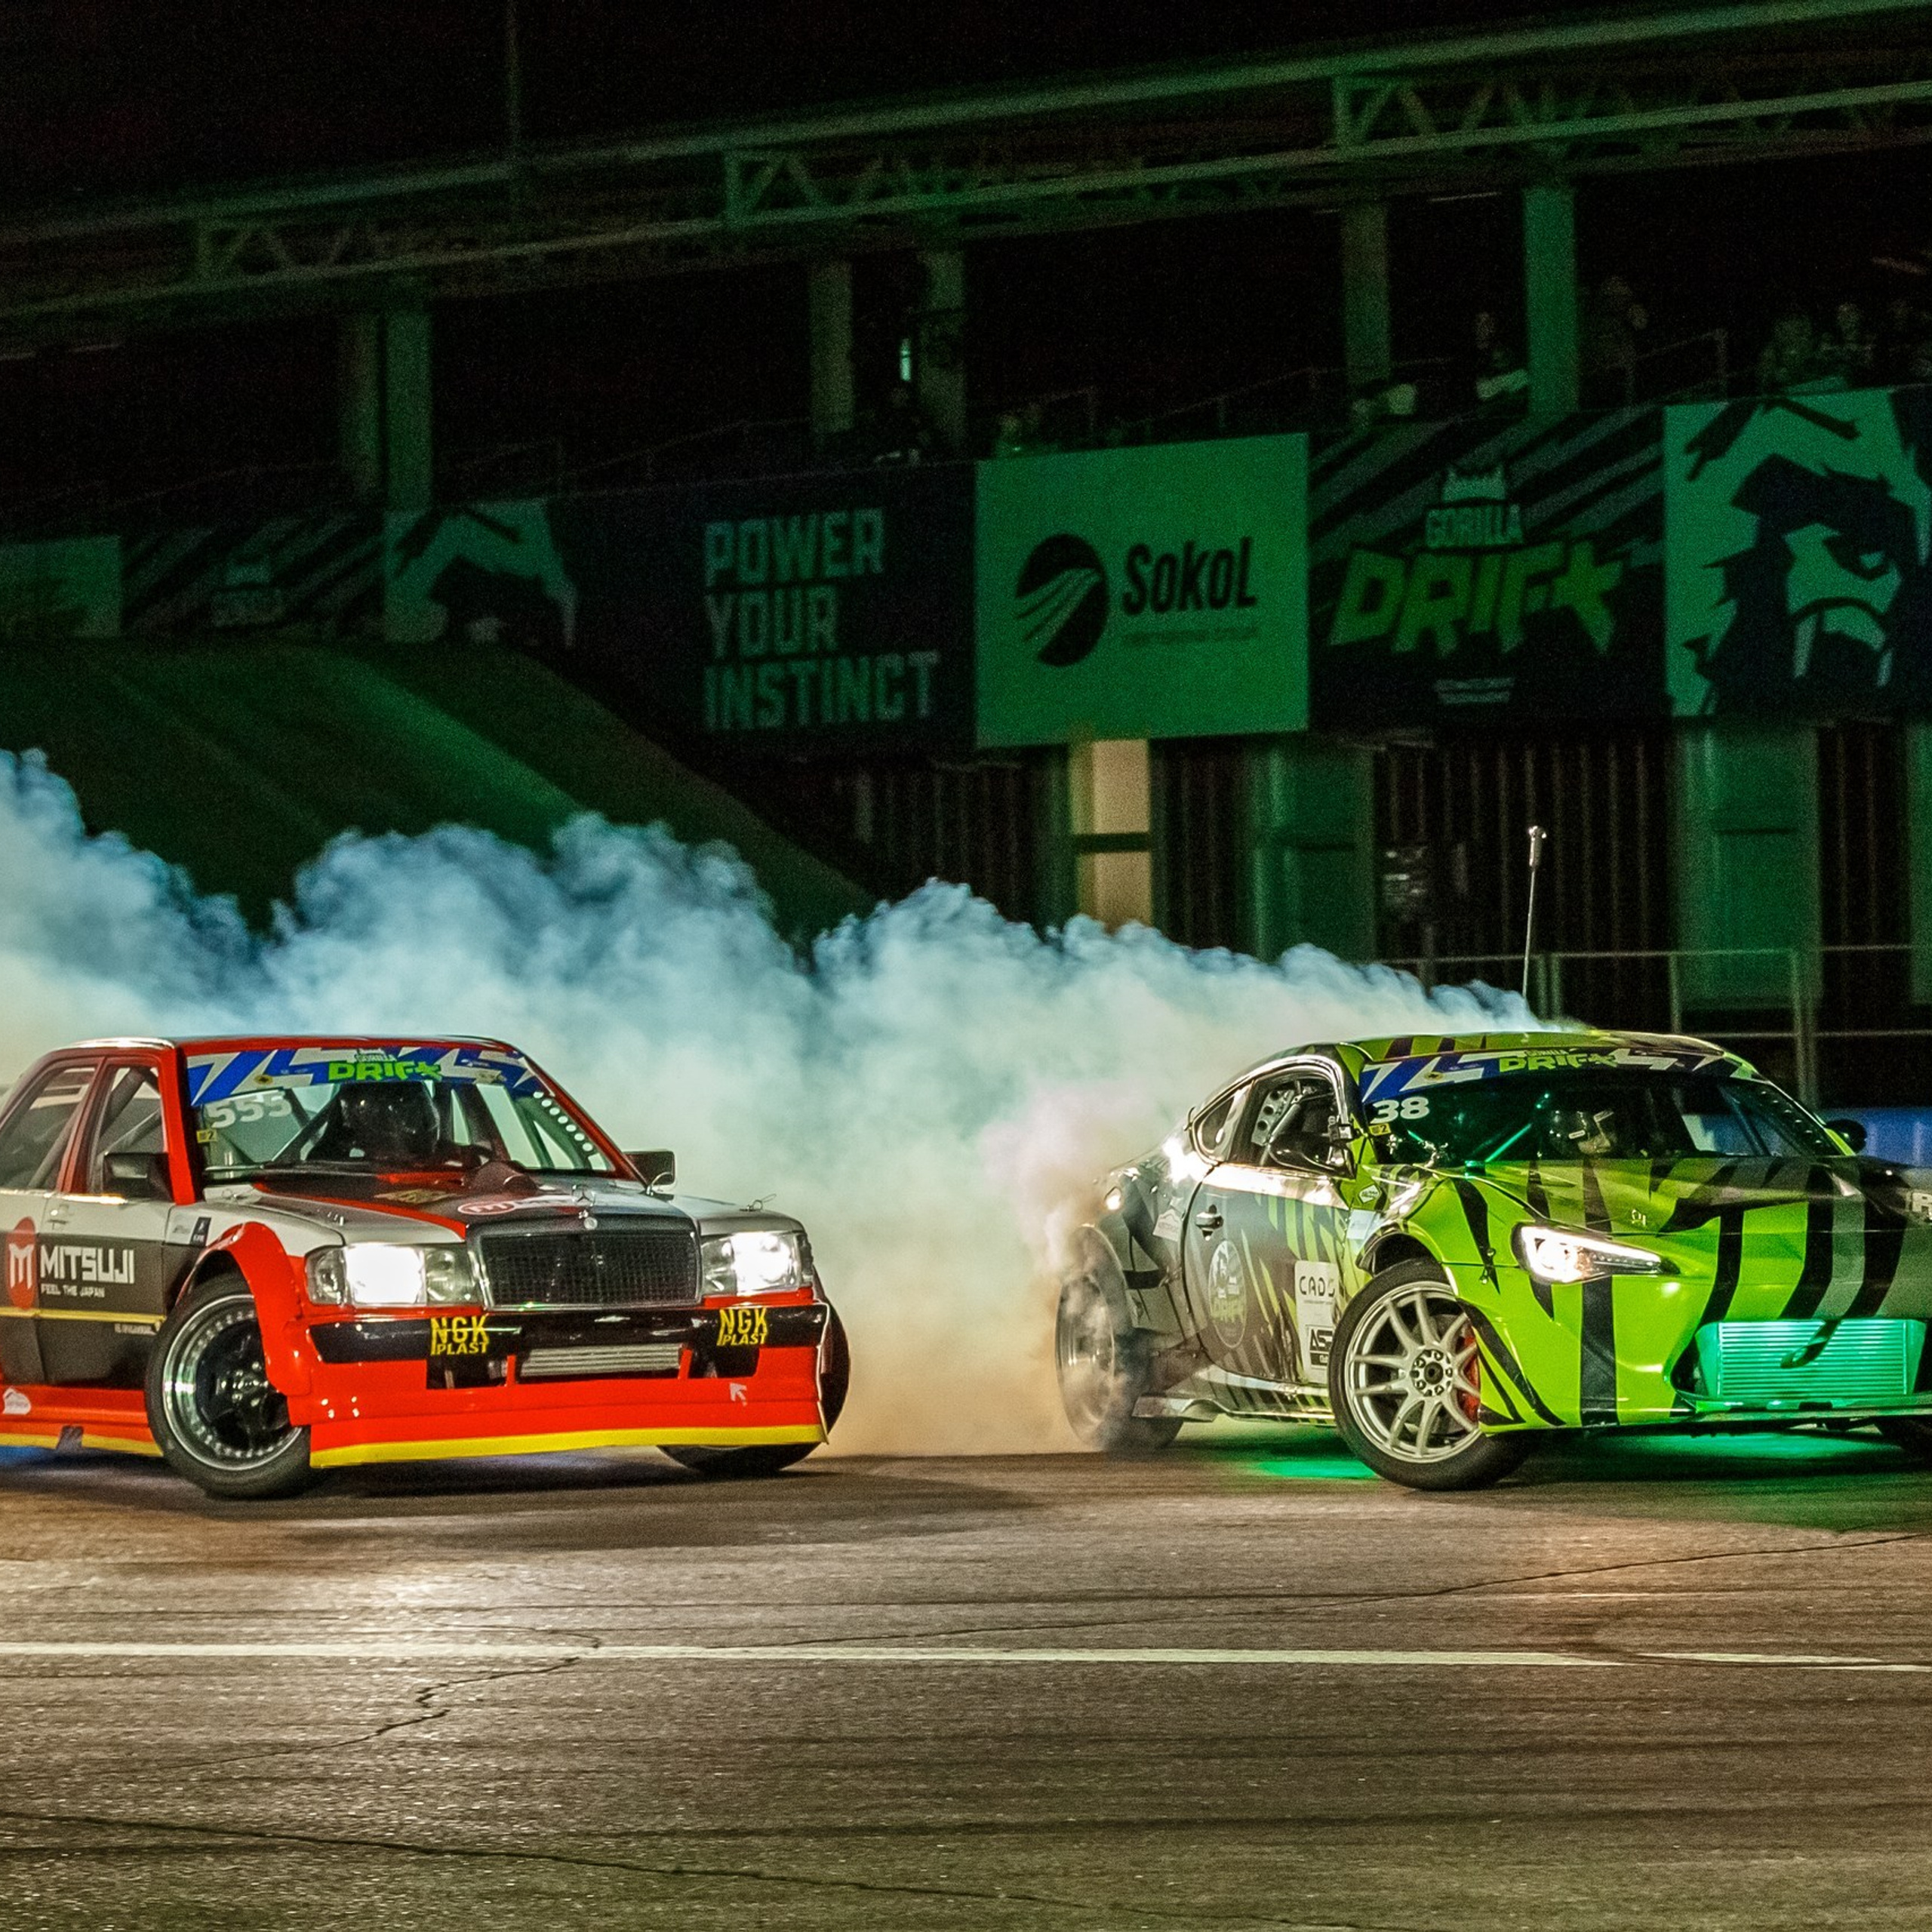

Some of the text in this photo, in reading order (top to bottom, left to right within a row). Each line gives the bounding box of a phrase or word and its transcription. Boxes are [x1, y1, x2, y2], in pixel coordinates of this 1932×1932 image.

[704, 508, 885, 588] POWER
[704, 583, 837, 660] YOUR
[703, 651, 940, 731] INSTINCT
[205, 1093, 292, 1128] 555
[1370, 1097, 1430, 1124] 38
[1380, 1124, 1387, 1133] 2
[40, 1245, 134, 1284] MITSUJI
[80, 1286, 105, 1298] JAPAN
[431, 1315, 489, 1345] NGK
[719, 1307, 768, 1335] NGK
[436, 1341, 488, 1355] PLAST
[722, 1333, 767, 1346] PLAST
